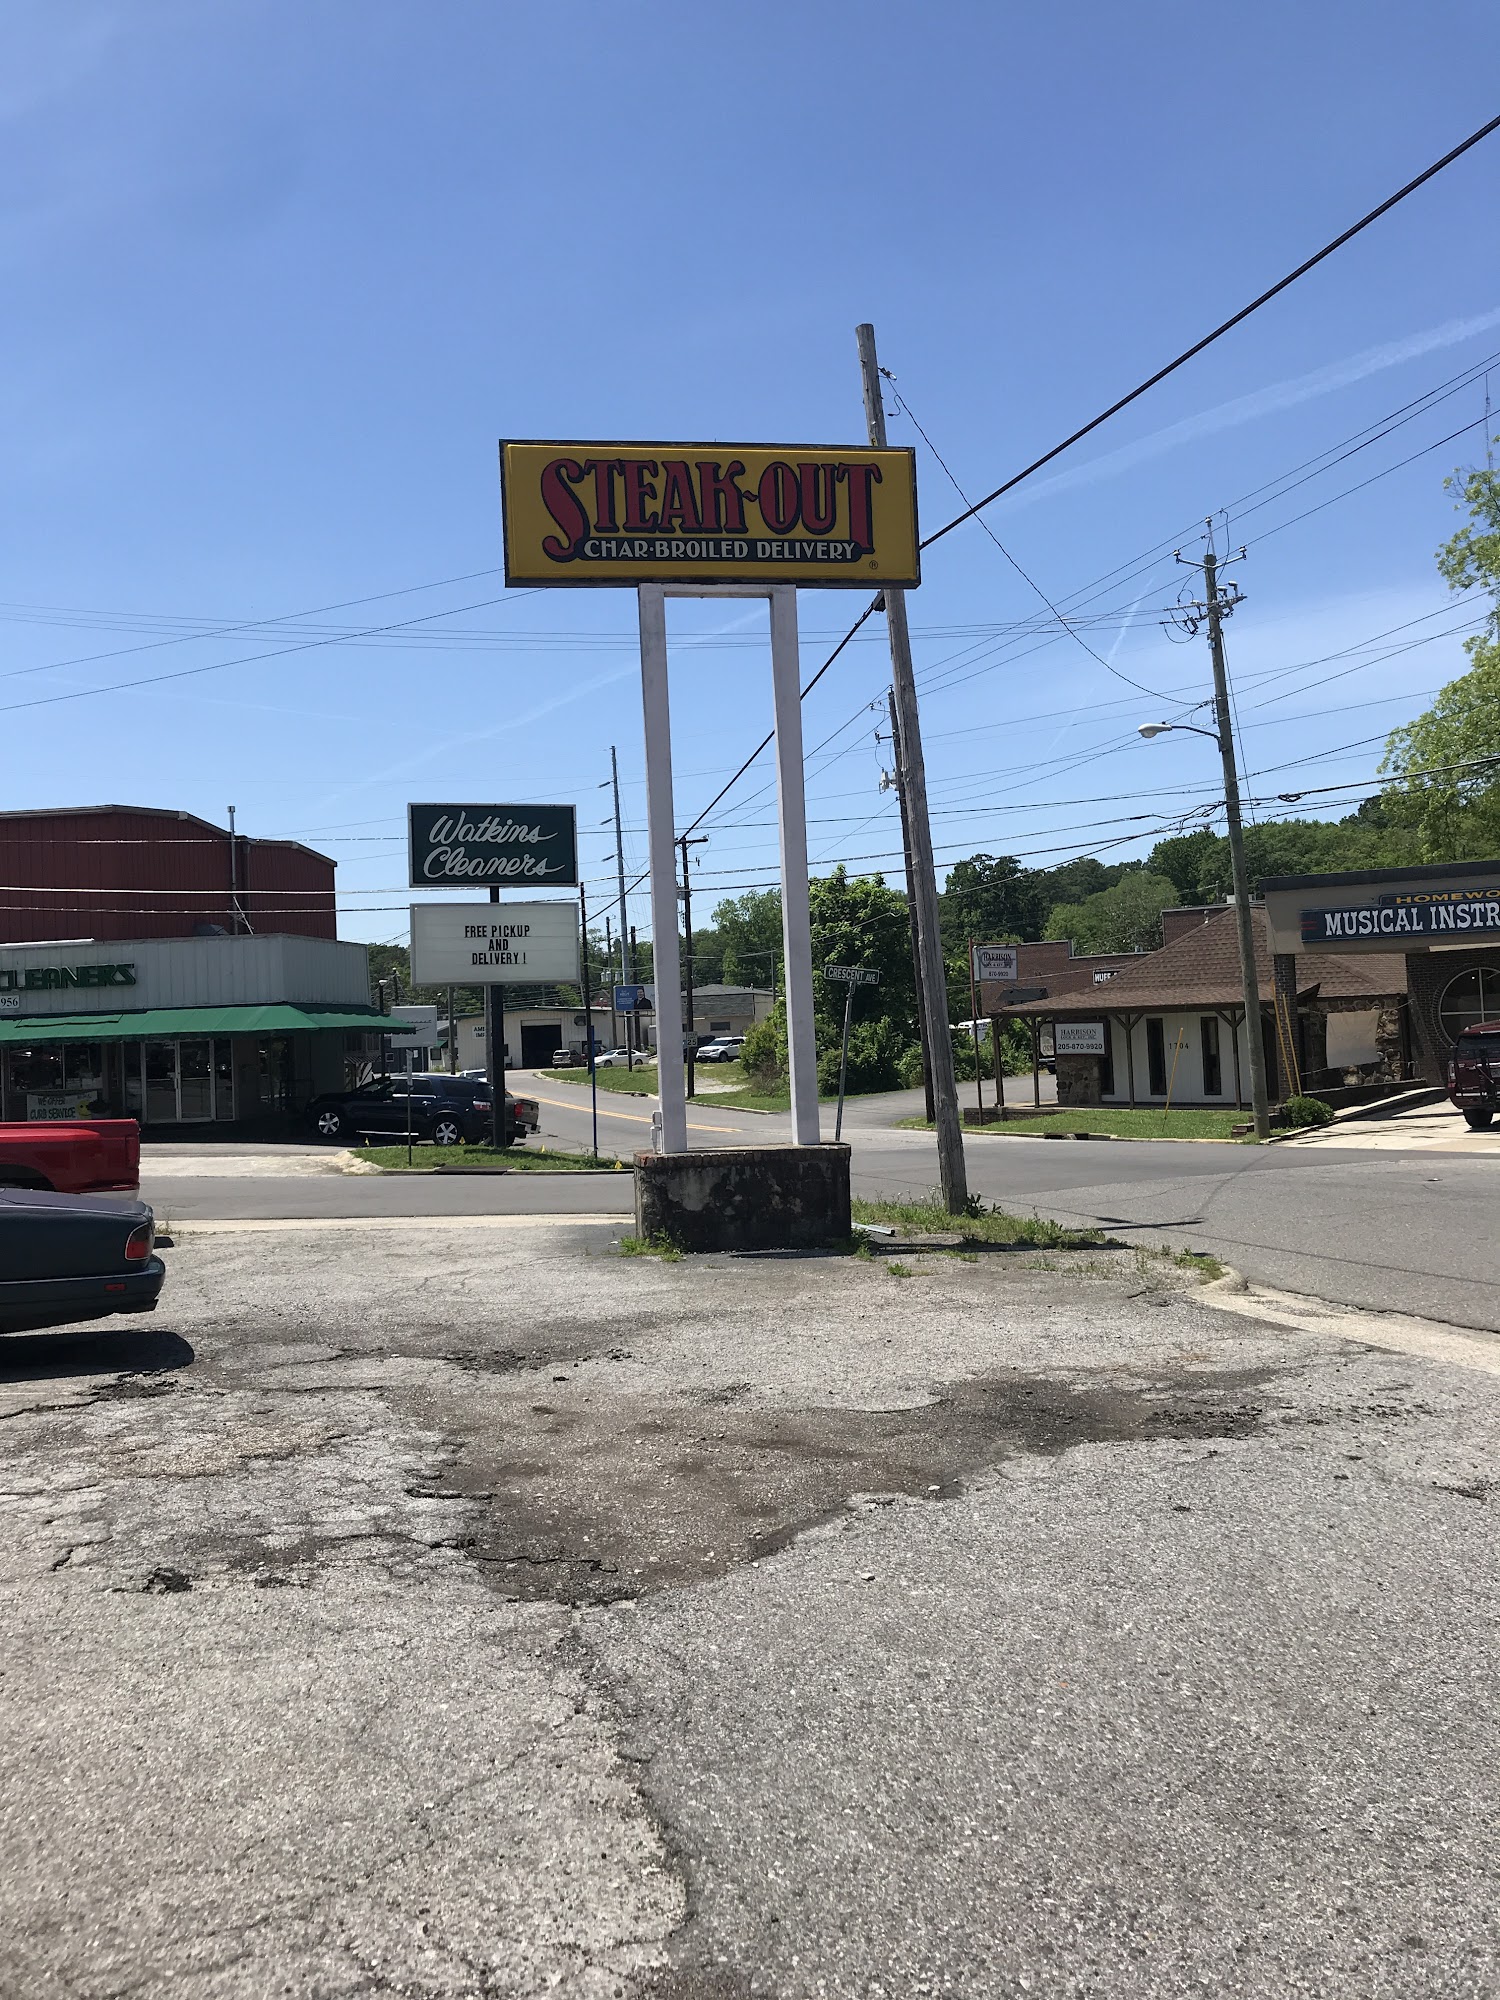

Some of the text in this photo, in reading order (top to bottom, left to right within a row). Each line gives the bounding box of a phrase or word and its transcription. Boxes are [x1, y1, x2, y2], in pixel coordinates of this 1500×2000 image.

[757, 540, 856, 560] DELIVERY
[428, 810, 559, 845] Watkins
[423, 846, 566, 878] Cleaners
[1324, 907, 1424, 937] MUSICAL
[464, 924, 530, 938] FREE PICKUP
[488, 938, 509, 951] AND
[472, 952, 519, 965] DELIVERY
[828, 967, 876, 982] CRESCENT AVE
[1060, 1028, 1097, 1036] HARBISON
[1168, 1042, 1189, 1050] 1704
[37, 1096, 66, 1106] WE OFFER
[30, 1107, 76, 1120] CURB SERVICE
